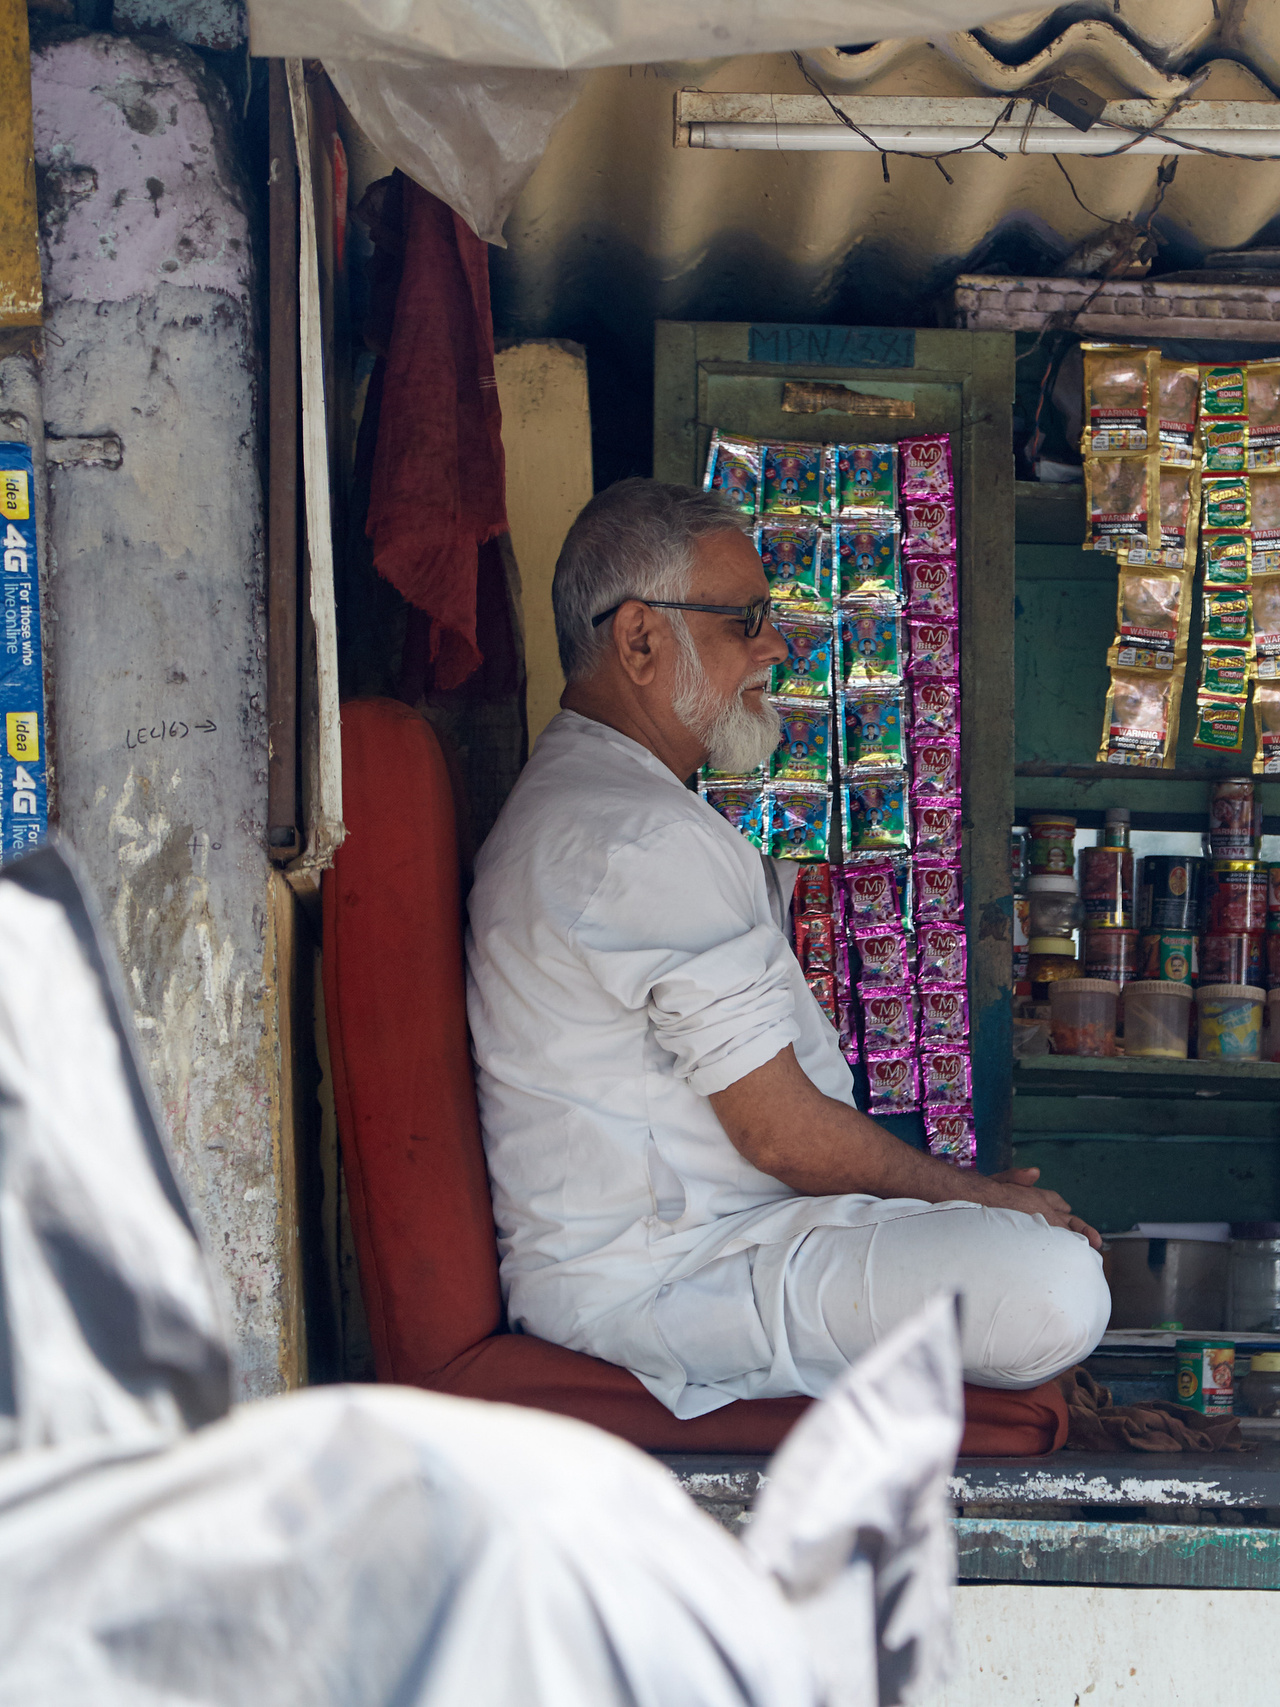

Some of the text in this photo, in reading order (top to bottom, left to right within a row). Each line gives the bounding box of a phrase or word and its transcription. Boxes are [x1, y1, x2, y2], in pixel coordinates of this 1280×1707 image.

[919, 447, 940, 460] My
[922, 508, 943, 520] My
[4, 523, 28, 573] 4G
[925, 569, 946, 581] My
[915, 581, 935, 589] Bite
[4, 583, 18, 654] live online
[20, 582, 33, 665] For those who
[927, 630, 948, 642] My
[1130, 628, 1168, 638] WARNING
[930, 691, 946, 703] My
[1119, 728, 1158, 738] WARNING
[931, 752, 949, 765] My
[13, 766, 36, 814] 4G
[932, 813, 950, 826] My
[922, 826, 942, 834] Bite
[13, 825, 27, 849] live
[934, 875, 950, 887] My
[863, 880, 885, 895] My
[925, 887, 943, 895] Bite
[855, 893, 875, 902] Bite
[937, 936, 954, 948] My
[874, 943, 894, 957] My
[927, 948, 946, 956] Bite
[865, 956, 885, 964] Bite
[879, 1002, 899, 1015] My
[938, 997, 955, 1010] My
[870, 1016, 890, 1024] Bite
[885, 1065, 905, 1078] My
[941, 1060, 959, 1072] My
[876, 1079, 895, 1087] Bite
[945, 1122, 962, 1134] My
[936, 1134, 954, 1142] Bite
